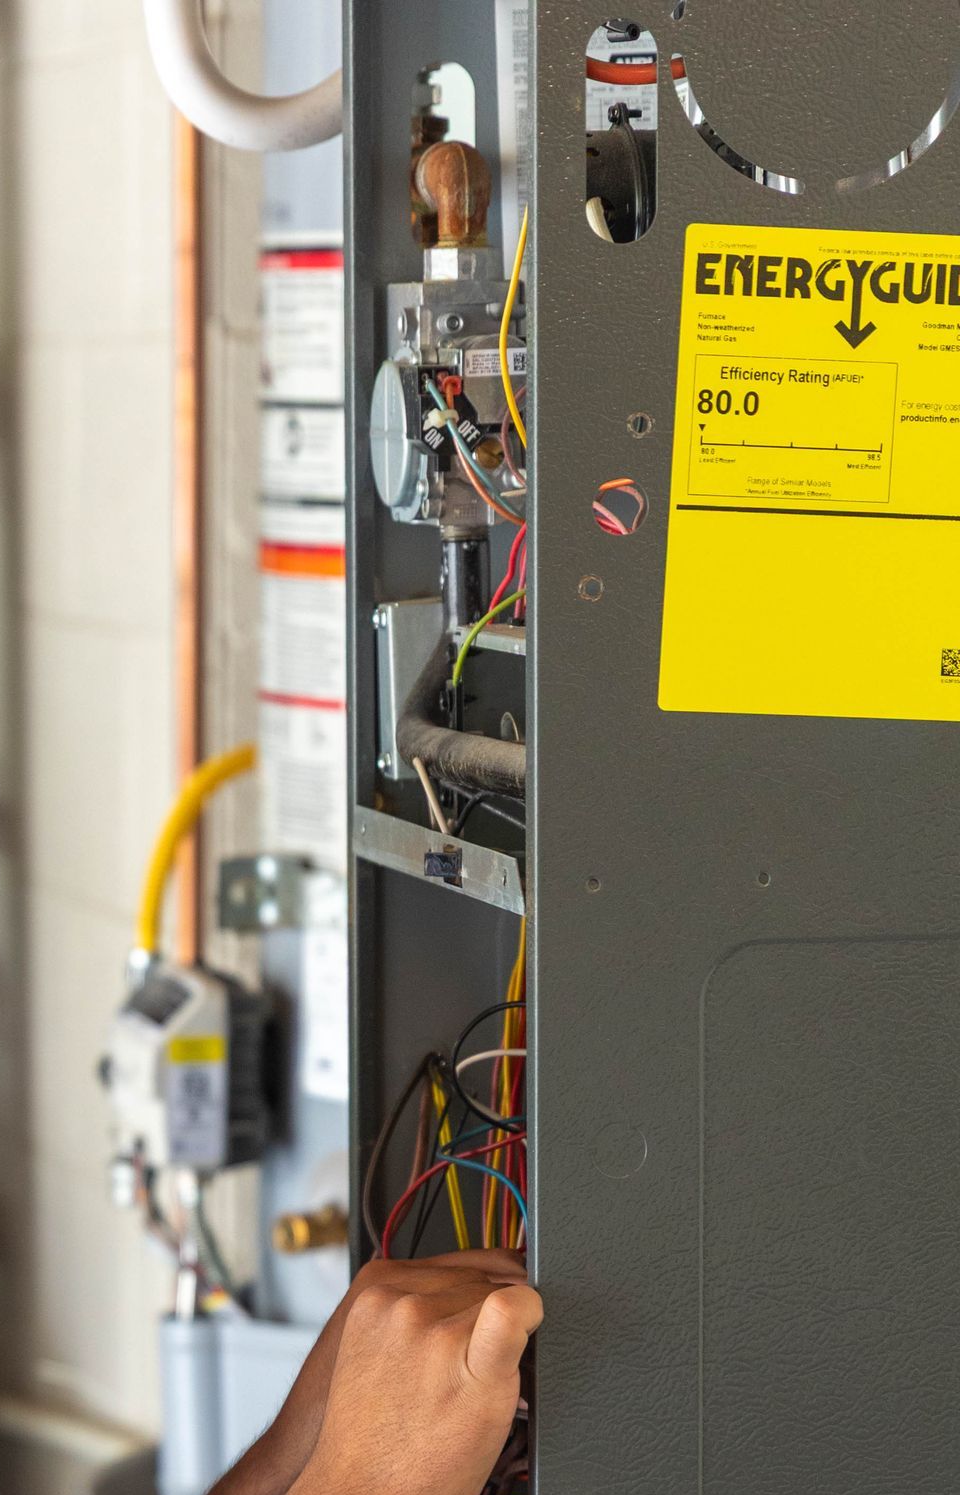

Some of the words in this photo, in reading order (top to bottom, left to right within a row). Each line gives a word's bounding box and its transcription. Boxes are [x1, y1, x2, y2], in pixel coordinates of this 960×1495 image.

[698, 312, 726, 321] Furnace
[697, 323, 755, 333] Non-weatherized
[922, 321, 955, 331] Goodman
[696, 334, 722, 342] Natural
[724, 335, 737, 343] Gas
[720, 366, 785, 385] Efficiency
[788, 369, 831, 388] Rating
[697, 388, 760, 416] 80.0
[424, 428, 445, 450] ON
[458, 420, 480, 443] OFF
